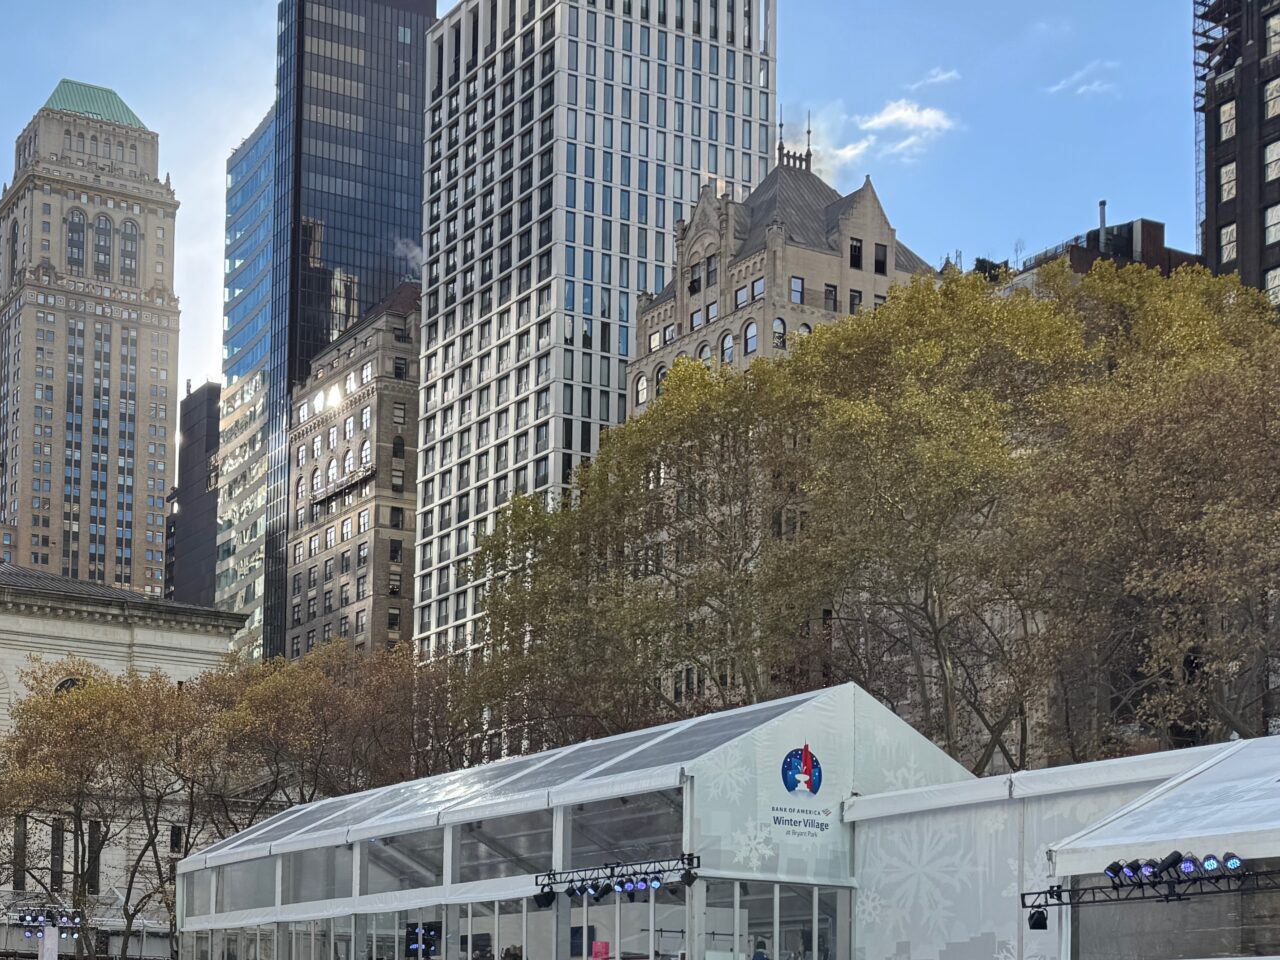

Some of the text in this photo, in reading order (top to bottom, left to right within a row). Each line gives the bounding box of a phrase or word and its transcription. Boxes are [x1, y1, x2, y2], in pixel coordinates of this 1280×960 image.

[796, 808, 821, 816] AMERICA
[772, 815, 829, 832] Winter Village
